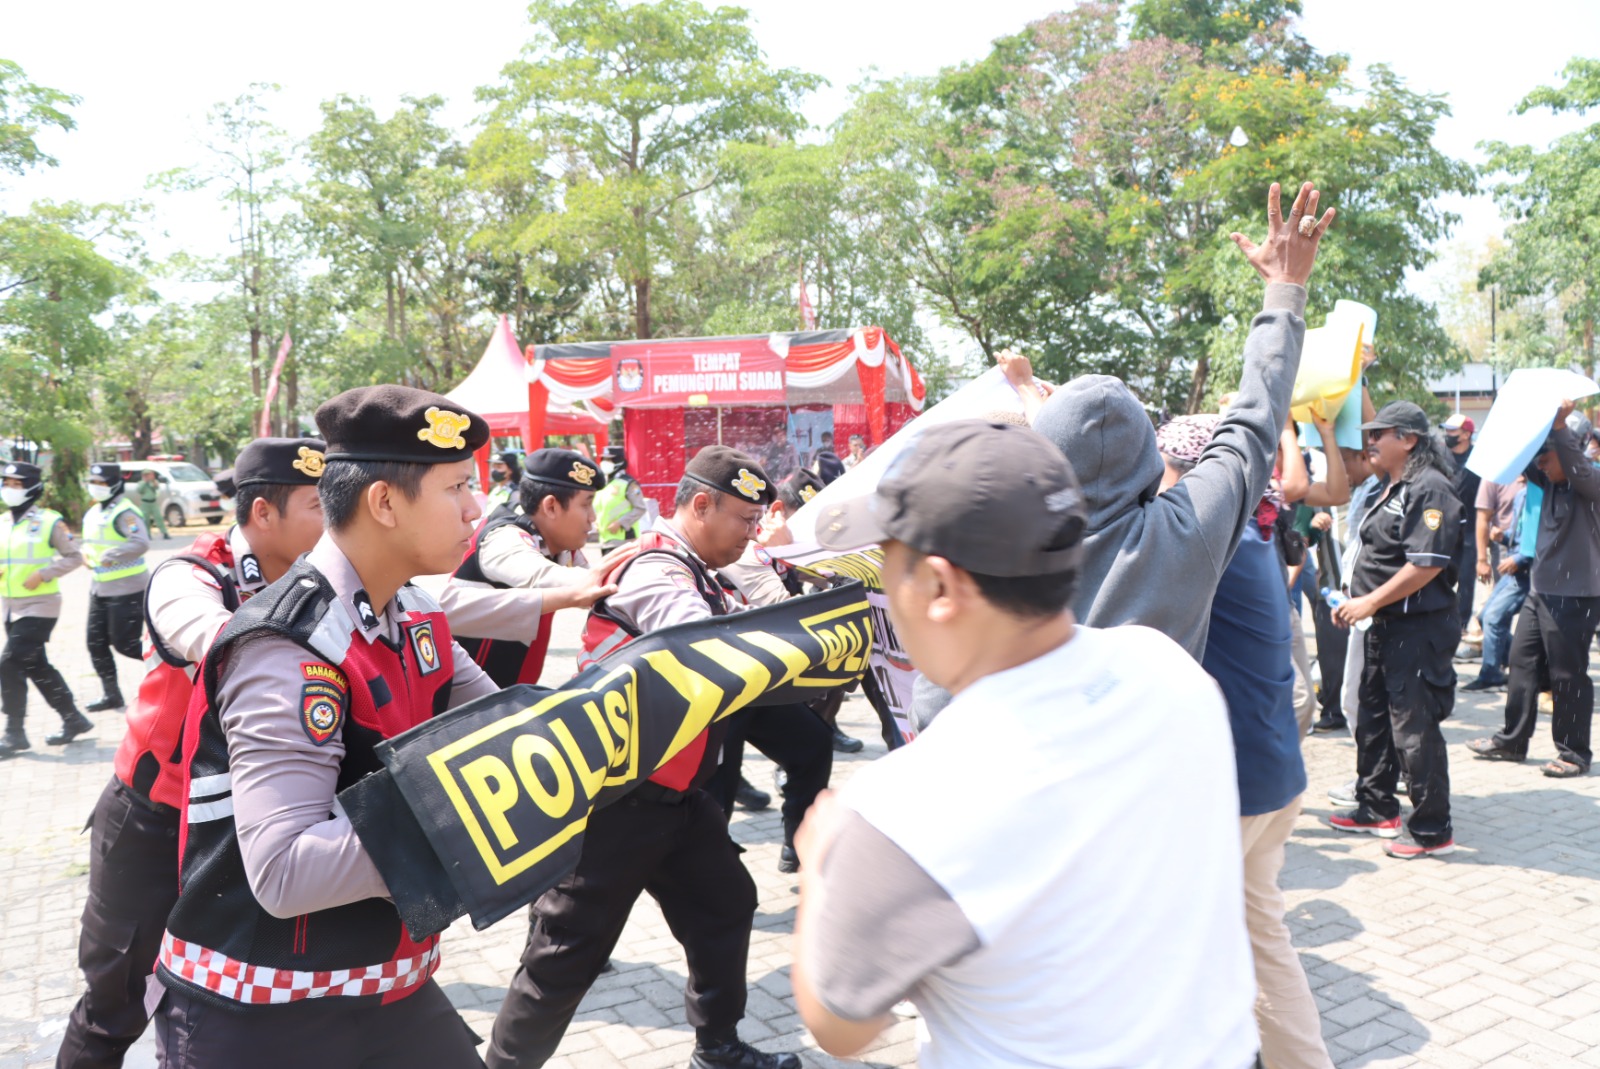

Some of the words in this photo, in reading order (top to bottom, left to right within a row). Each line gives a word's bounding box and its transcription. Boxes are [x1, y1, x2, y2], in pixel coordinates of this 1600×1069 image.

[692, 353, 741, 372] TEMPAT
[653, 373, 737, 393] PEMUNGUTAN
[739, 371, 783, 391] SUARA
